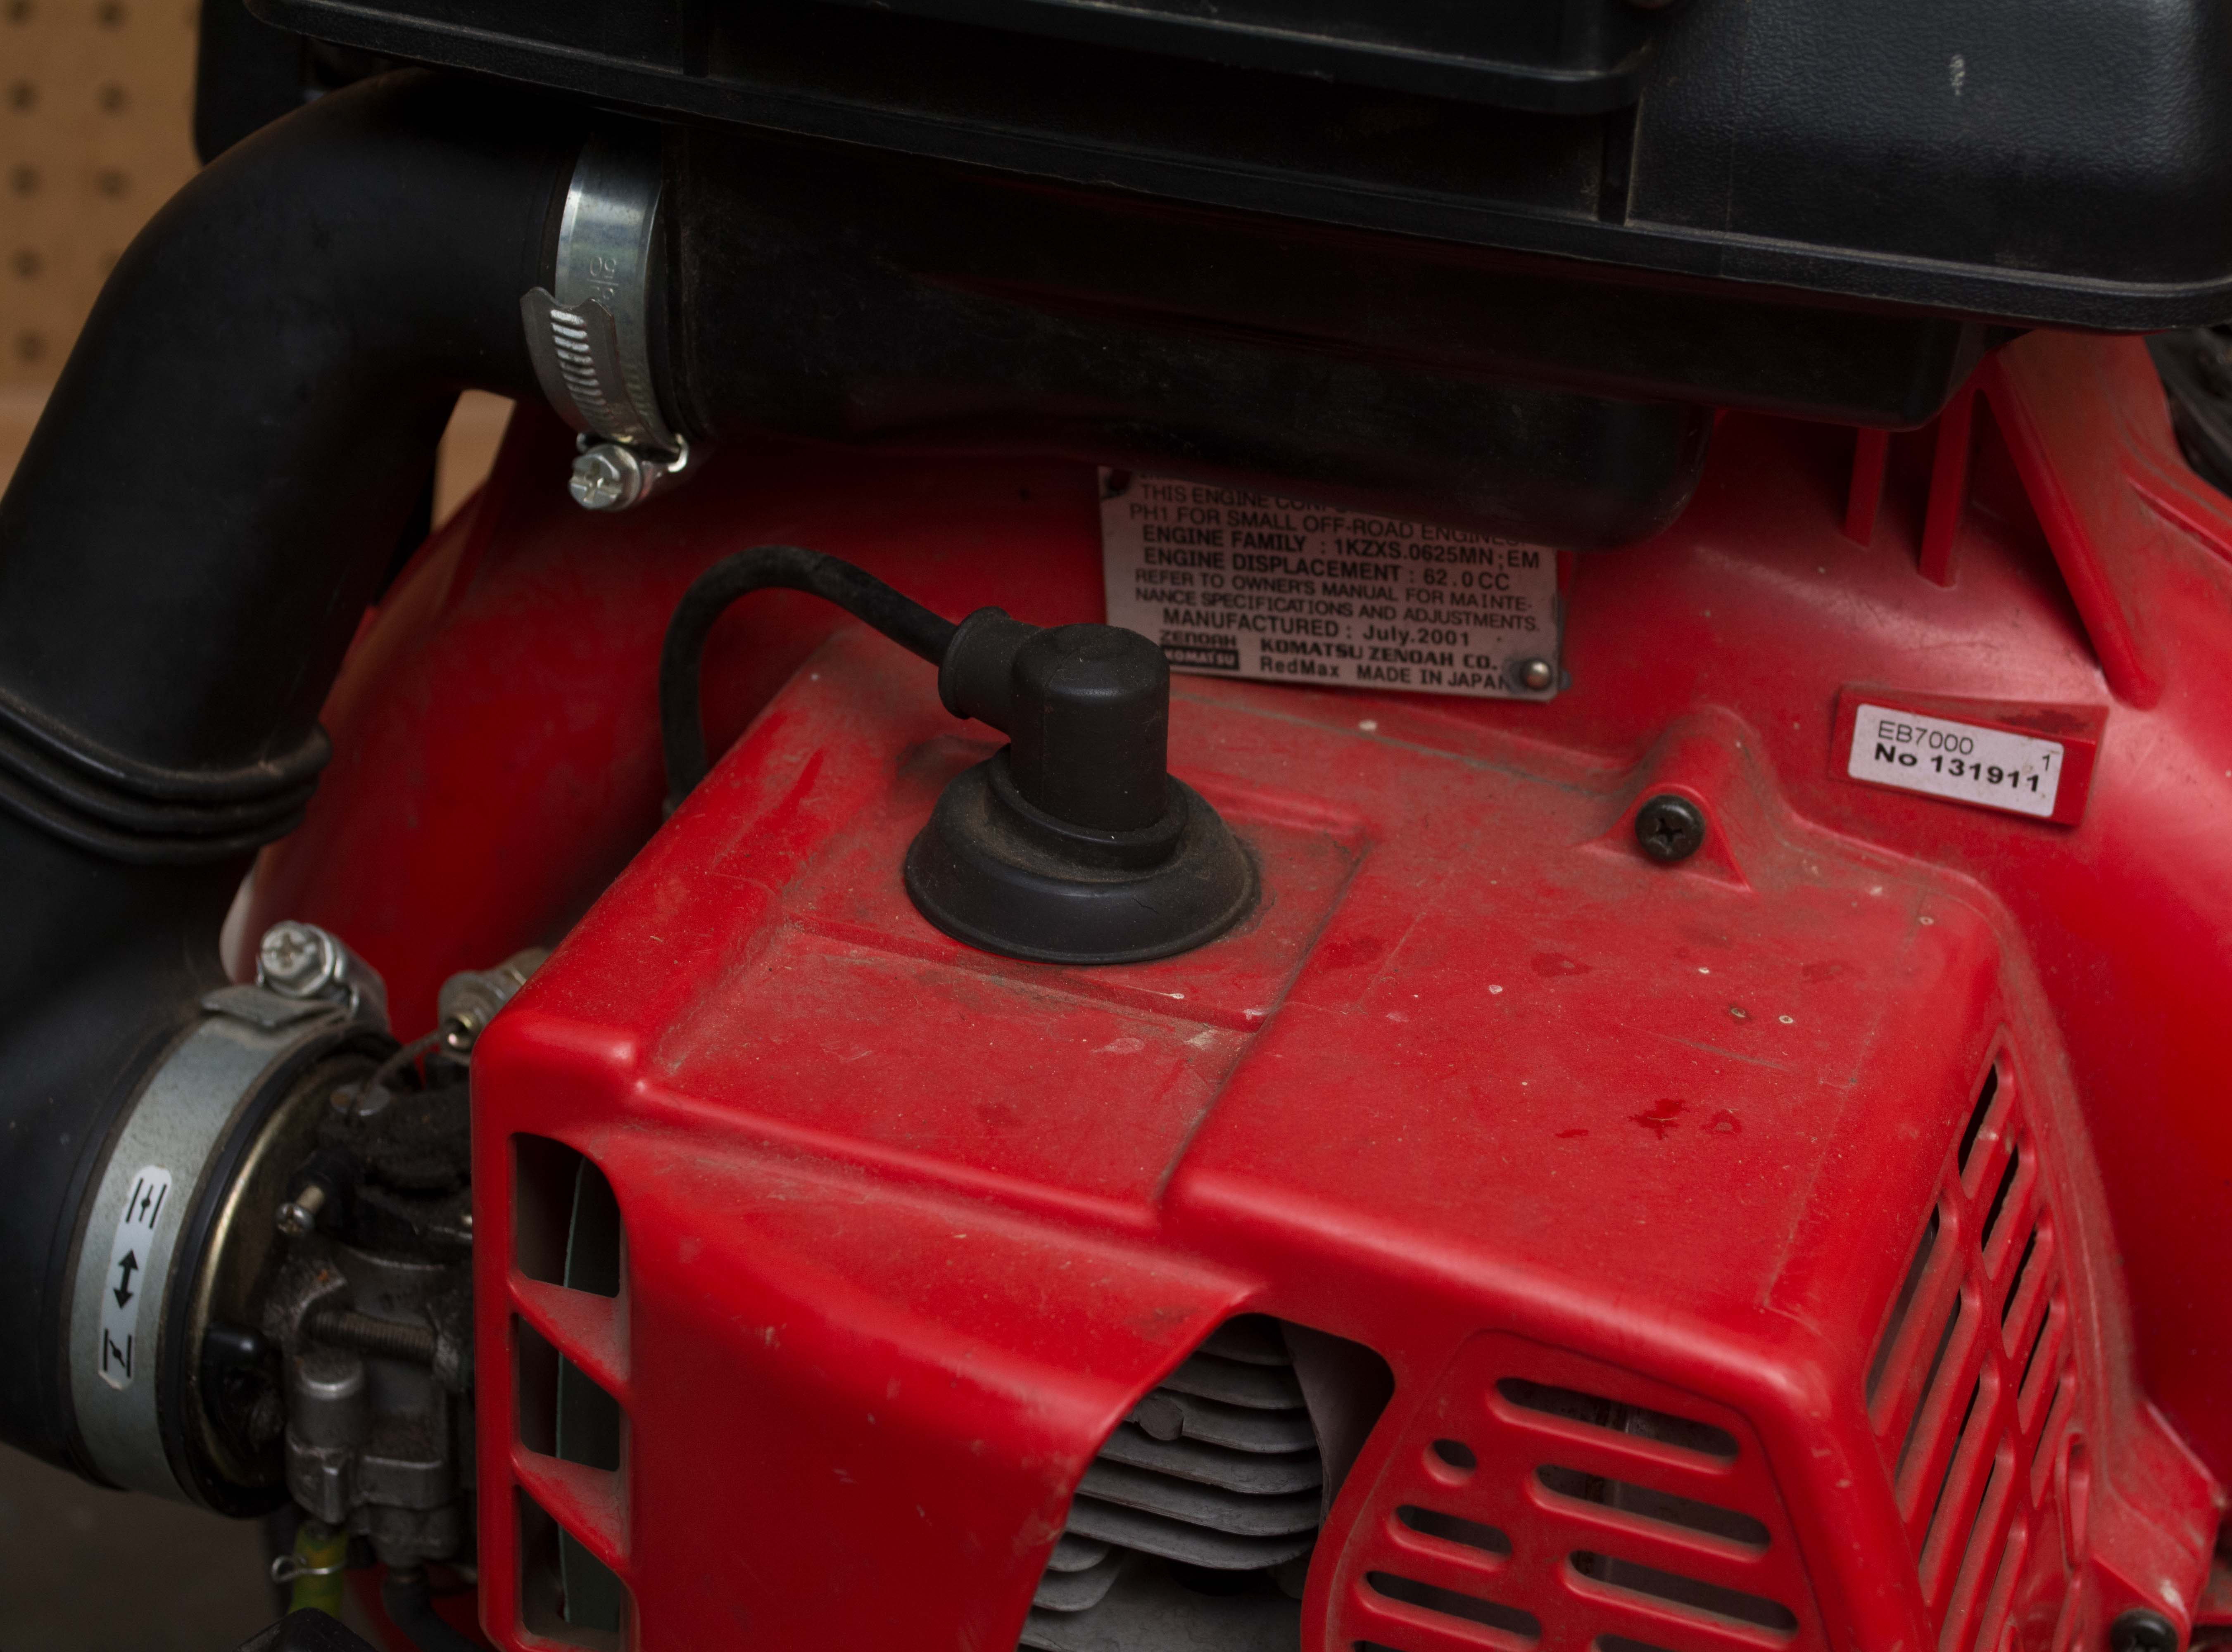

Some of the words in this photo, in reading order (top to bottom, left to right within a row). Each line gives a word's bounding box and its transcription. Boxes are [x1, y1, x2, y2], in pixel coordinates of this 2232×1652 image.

[1141, 484, 1186, 502] THIS
[1192, 487, 1270, 508] ENGINE
[1129, 503, 1168, 521] PH1
[1177, 507, 1220, 525] FOR
[1227, 510, 1296, 531] SMALL
[1303, 515, 1414, 538] OFF-ROAD
[1143, 524, 1224, 546] ENGINE
[1231, 530, 1306, 552] FAMILY
[1144, 546, 1224, 569] ENGINE
[1232, 553, 1400, 581] DISPLACEMENT
[1135, 568, 1193, 585] REFER
[1200, 572, 1224, 589] TO
[1232, 573, 1314, 594] OWNER'S
[1322, 582, 1398, 601] MANUAL
[1405, 588, 1444, 604] FOR
[1450, 592, 1531, 612] MAINTE-
[1136, 588, 1197, 605] NANCE
[1201, 592, 1353, 617] SPECIFICATIONS
[1360, 604, 1397, 620] AND
[1404, 608, 1539, 632] ADJUSTMENTS.
[1163, 608, 1338, 637] MANUFACTURED
[1261, 638, 1363, 660] KOMATSU
[1369, 646, 1453, 666] ZENOAH
[1464, 654, 1498, 670] CO.
[1261, 656, 1339, 678] RedMax
[1357, 664, 1411, 684] MADE
[1421, 669, 1442, 685] IN
[1878, 720, 1974, 755] EB7000
[1875, 743, 1917, 767] No
[1931, 756, 2039, 792] 131911
